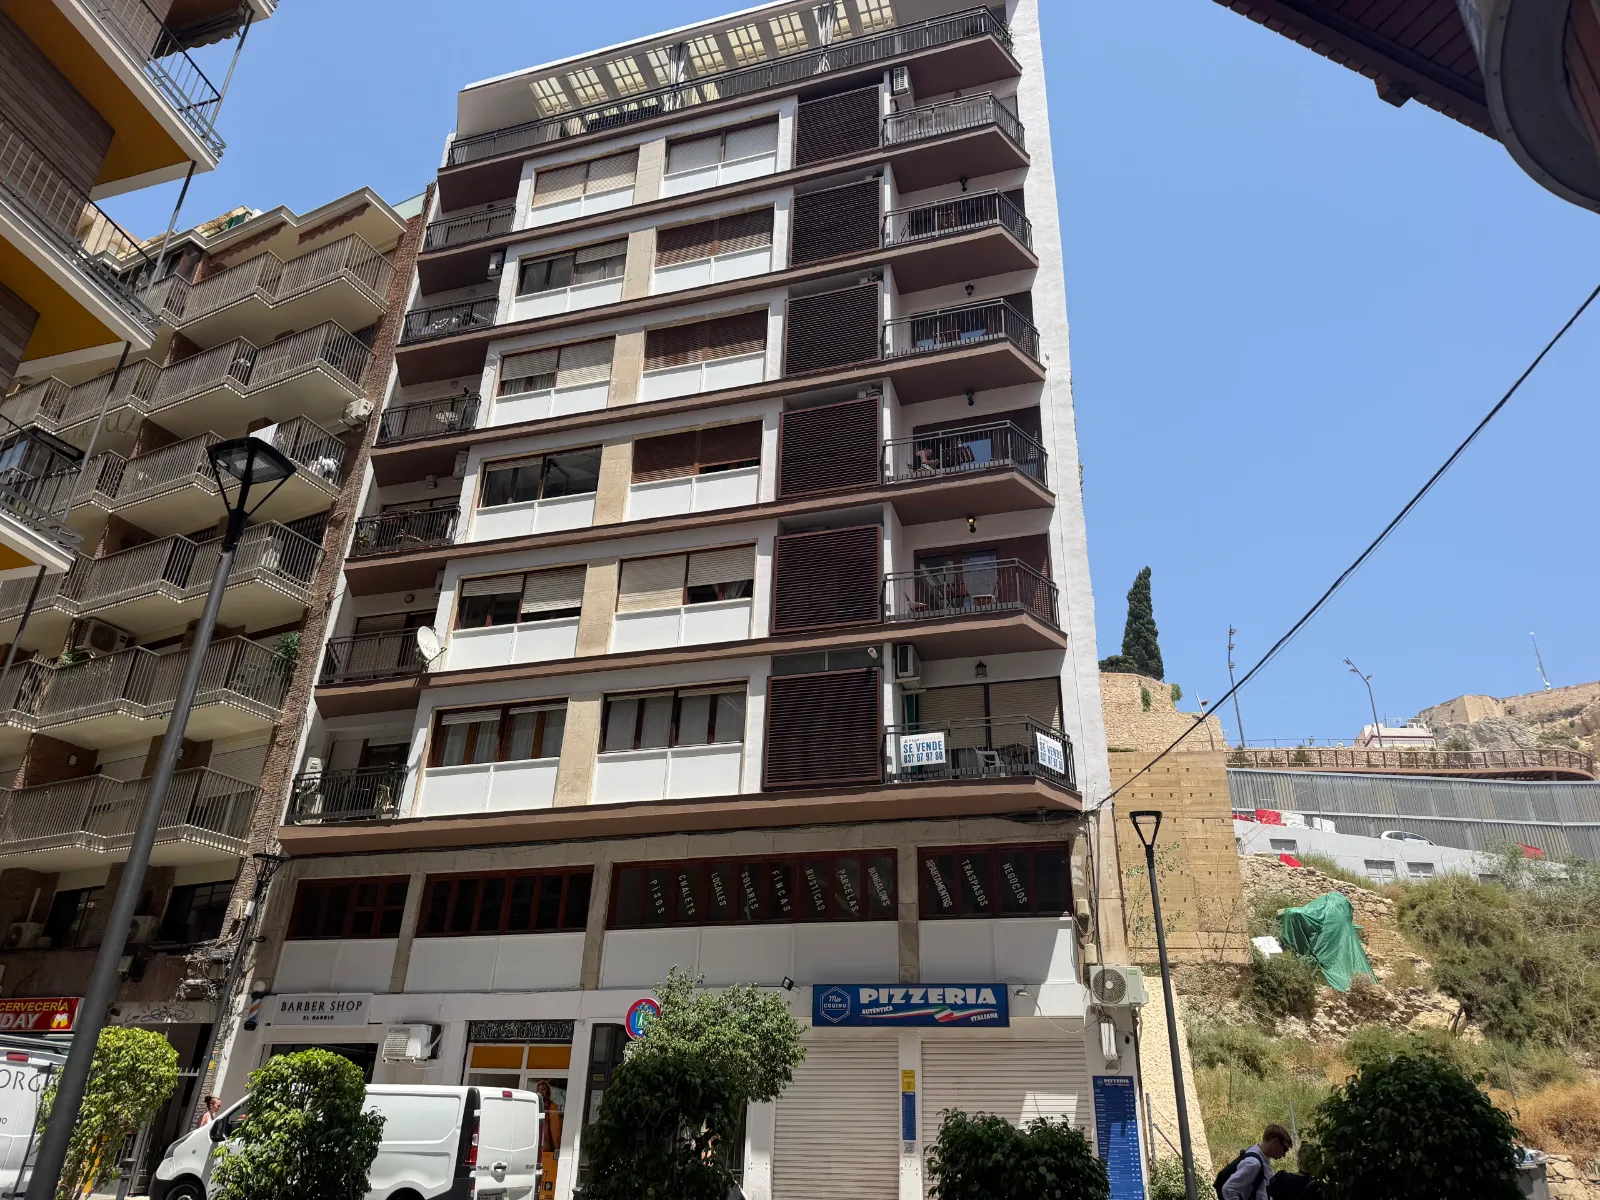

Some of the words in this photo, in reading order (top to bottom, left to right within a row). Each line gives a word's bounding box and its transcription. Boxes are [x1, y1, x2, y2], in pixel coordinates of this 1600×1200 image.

[903, 743, 913, 754] SE
[916, 741, 943, 752] VENDE
[916, 752, 924, 763] 87
[926, 751, 933, 761] 97
[678, 874, 696, 915] CHALETS
[710, 871, 727, 906] LOCALES
[741, 871, 759, 910] SOLARES
[805, 868, 826, 911] RUSTICAS
[837, 869, 859, 912] PARCELAS
[868, 866, 891, 907] BUNGALOWS
[925, 859, 953, 908] APARTAMENTOS
[961, 859, 989, 907] TRASPASOS
[281, 1001, 325, 1012] BARBER
[330, 1000, 363, 1011] SHOP
[859, 988, 997, 1005] PIZZERIA
[970, 1012, 998, 1022] ITALIANA
